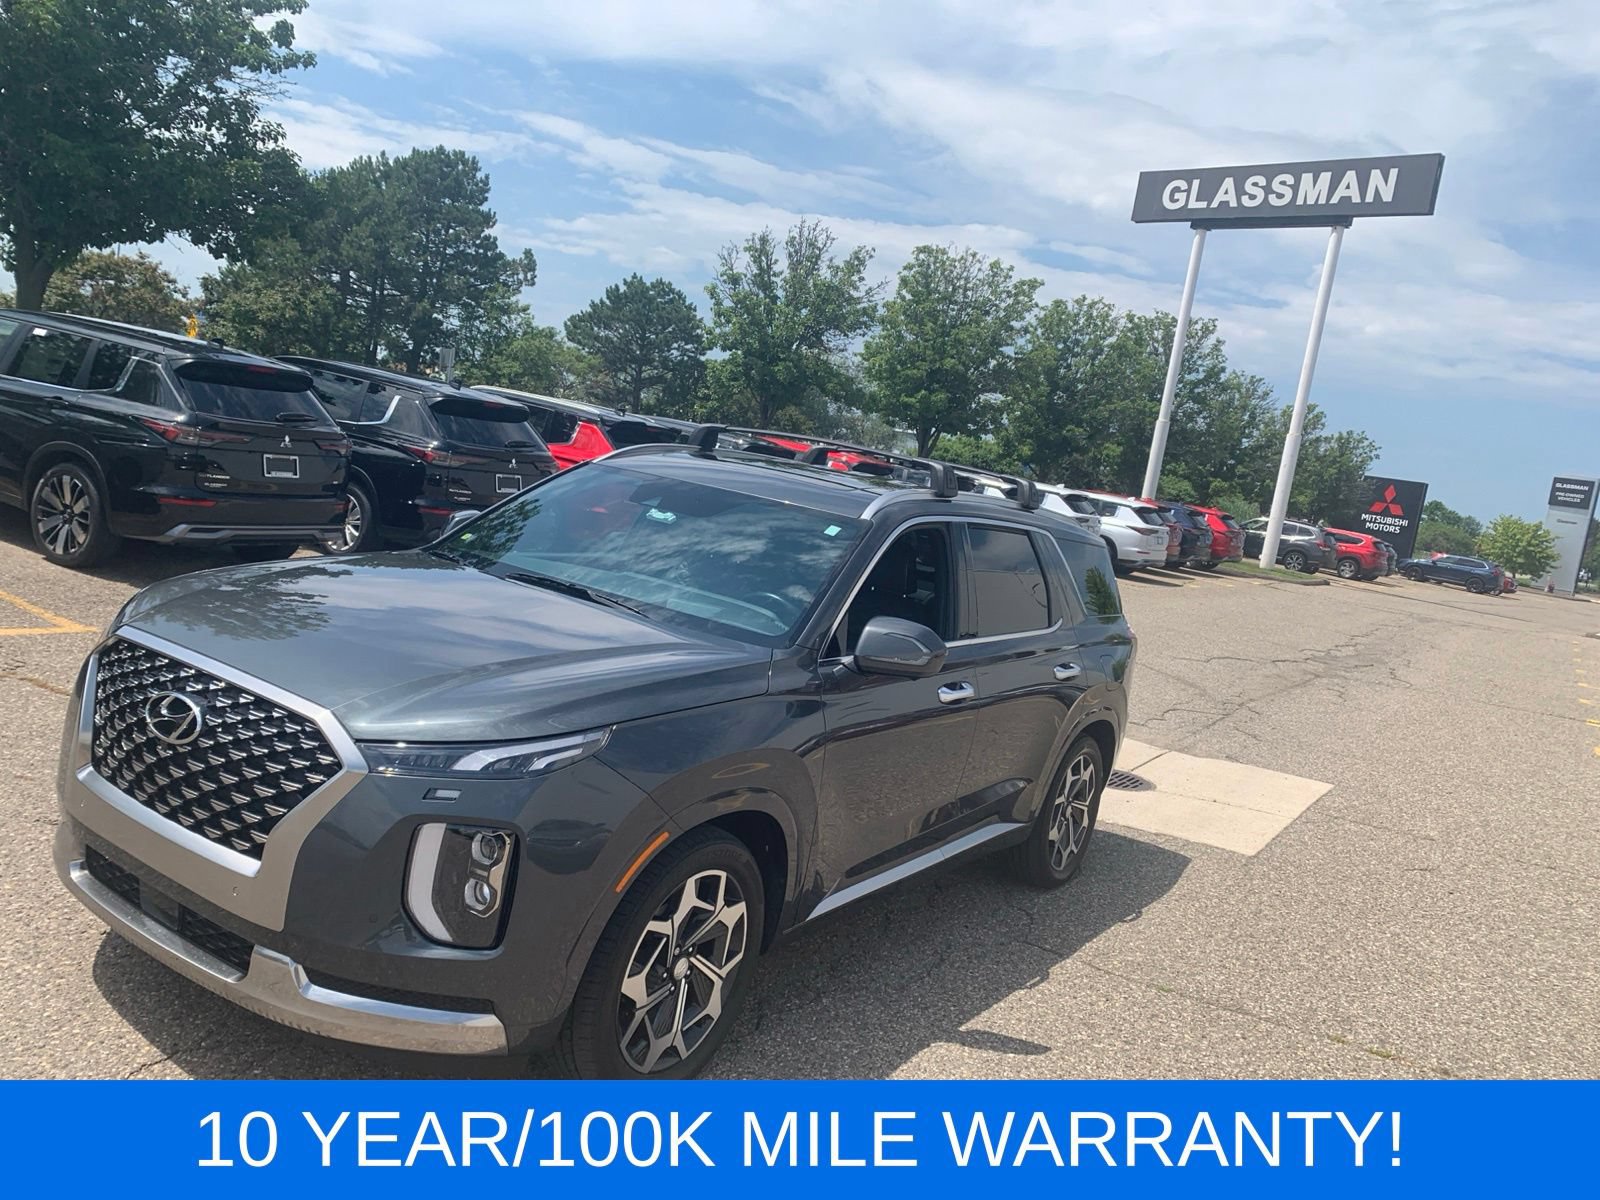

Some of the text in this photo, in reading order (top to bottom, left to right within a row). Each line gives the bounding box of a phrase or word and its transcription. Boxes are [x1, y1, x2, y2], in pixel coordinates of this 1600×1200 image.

[1161, 167, 1400, 211] GLASSMAN
[1555, 482, 1589, 491] GLASSMAN
[1361, 513, 1409, 527] MITSUBISHI
[1365, 522, 1401, 534] MOTORS
